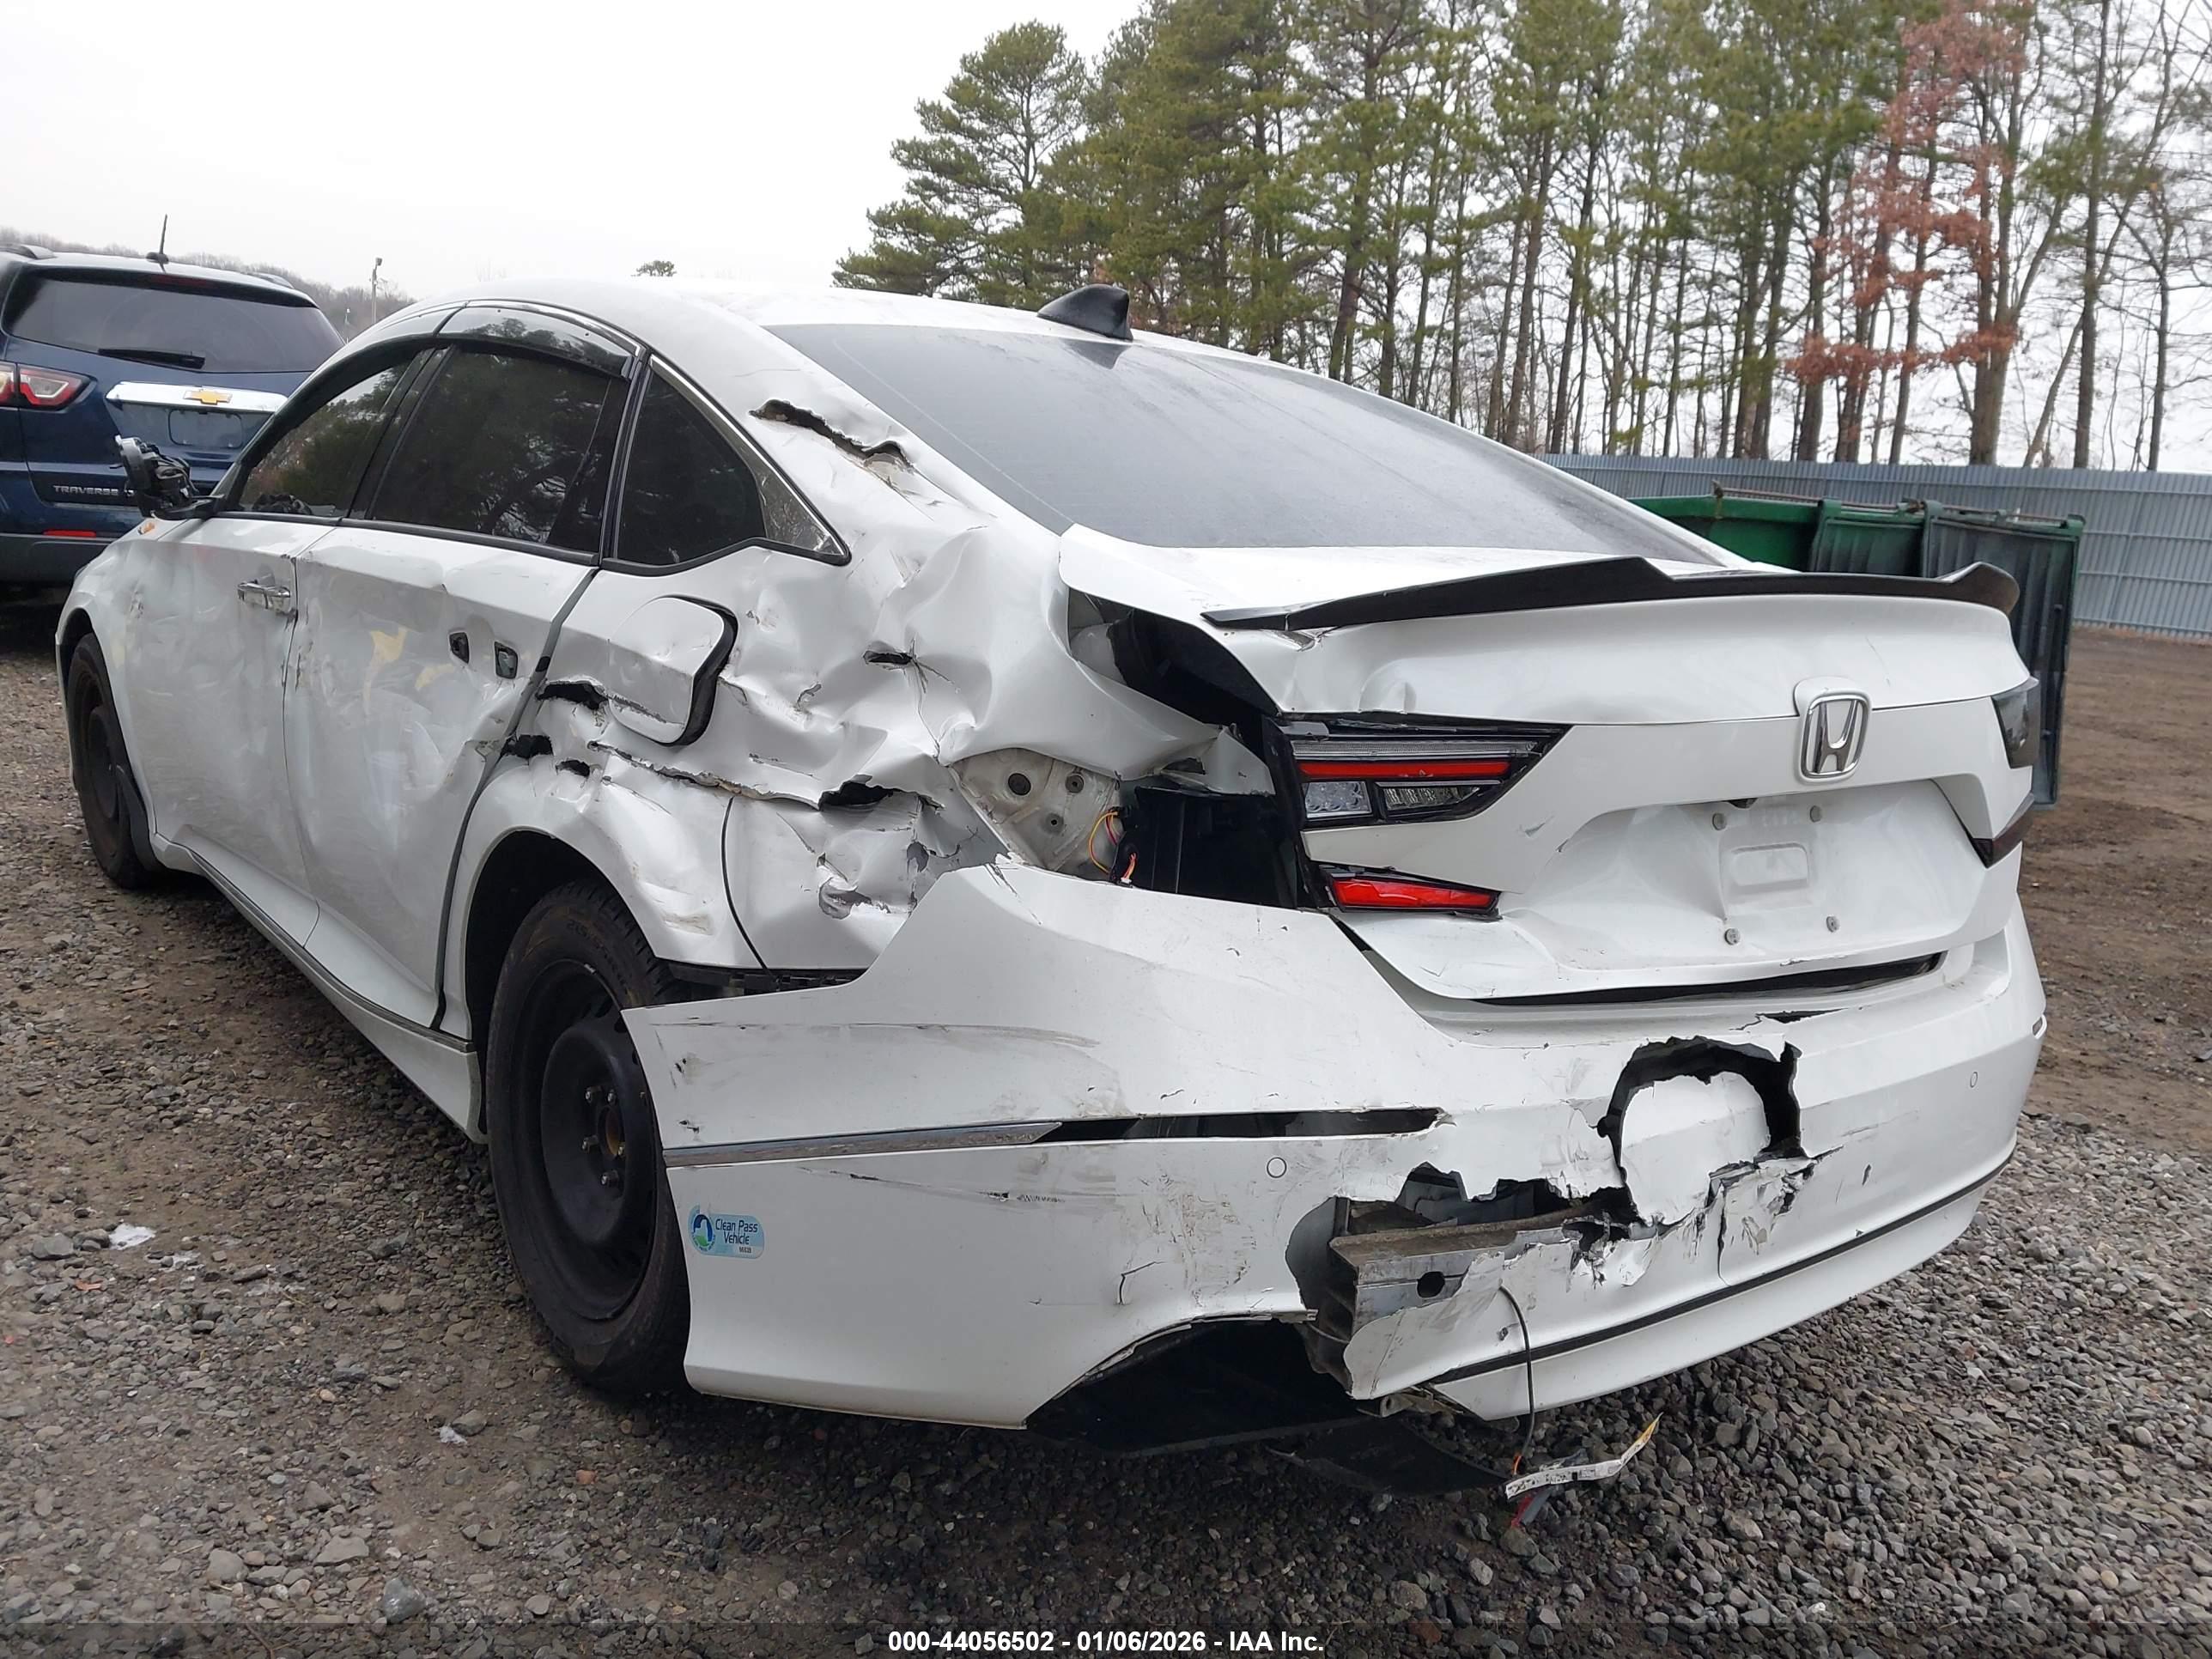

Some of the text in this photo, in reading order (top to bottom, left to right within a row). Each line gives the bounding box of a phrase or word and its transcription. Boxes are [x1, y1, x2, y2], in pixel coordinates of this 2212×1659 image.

[52, 485, 118, 495] TRAVERSE
[715, 1218, 758, 1232] Clean Pass
[724, 1231, 750, 1244] Vehicle
